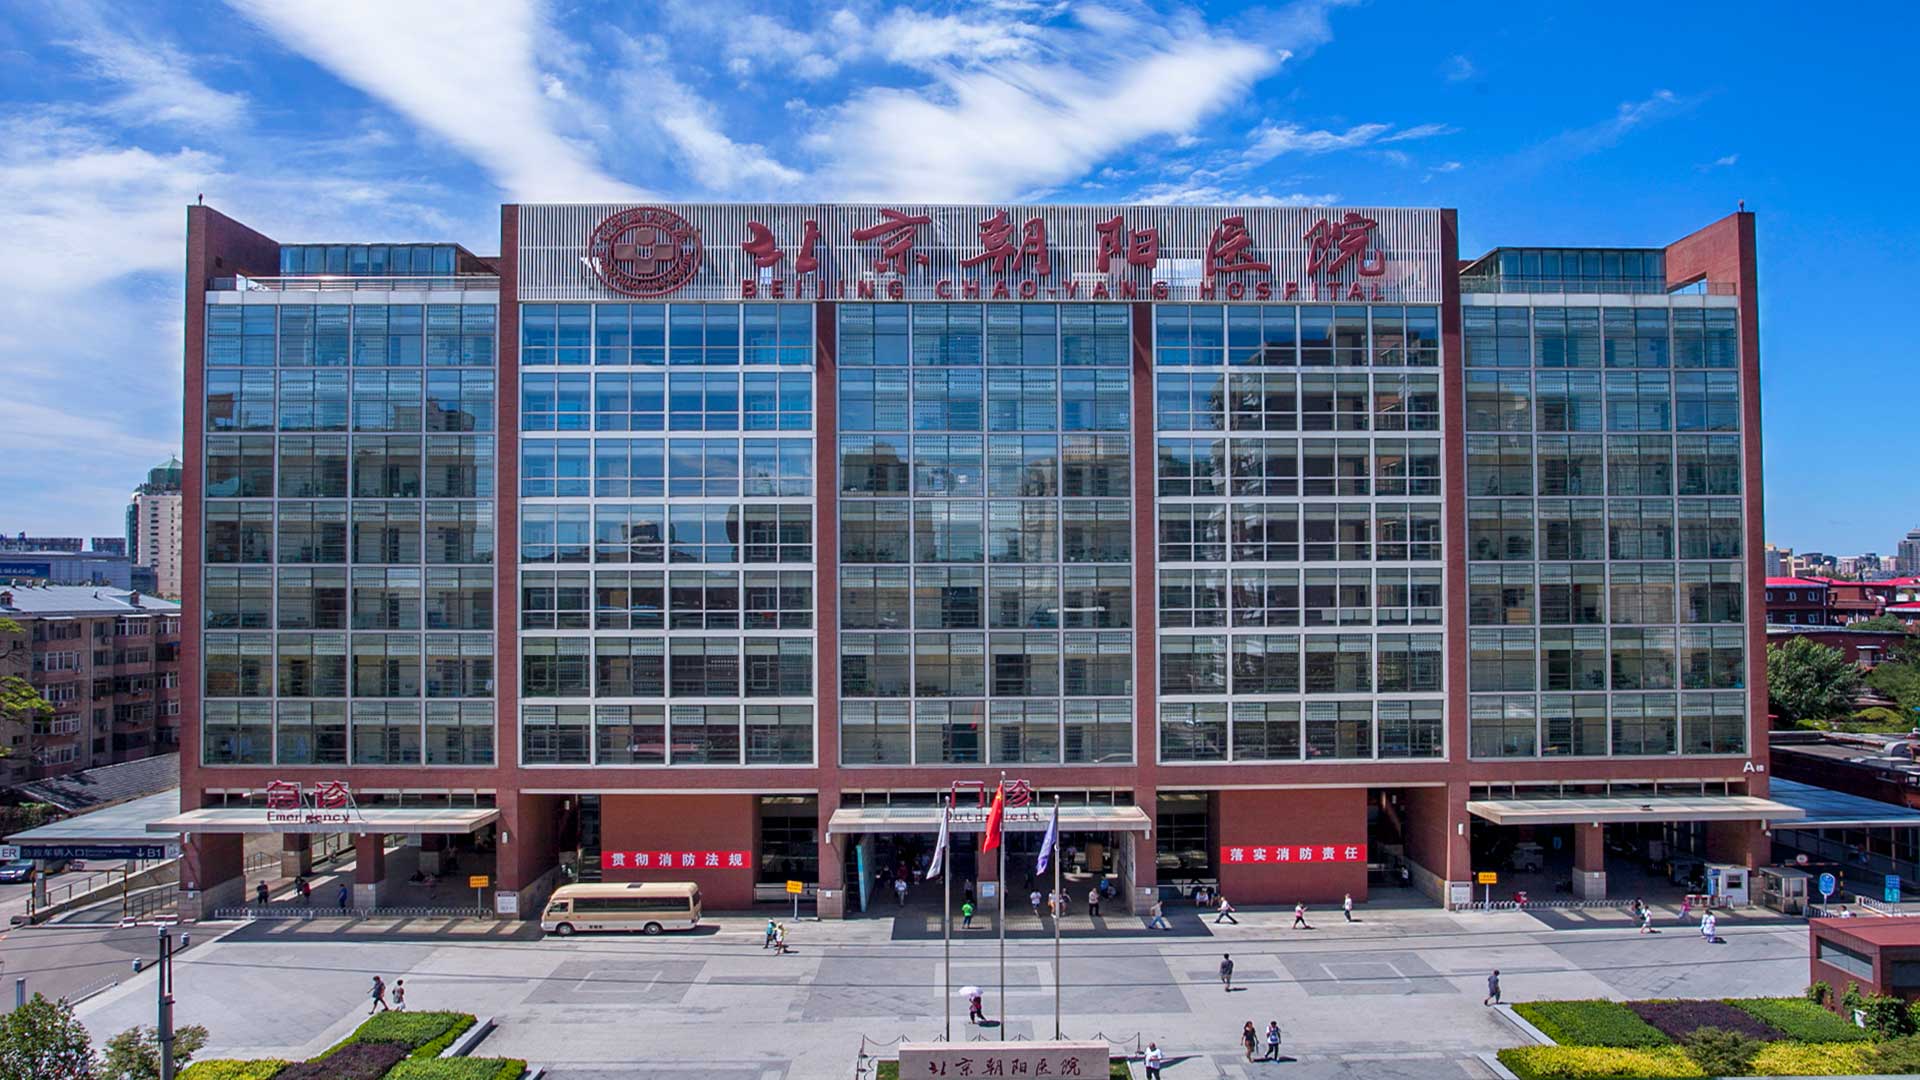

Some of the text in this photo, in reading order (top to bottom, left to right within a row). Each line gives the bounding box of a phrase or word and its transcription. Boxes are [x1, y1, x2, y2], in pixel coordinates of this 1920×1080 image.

[742, 208, 1385, 276] 北京朝阳医院
[742, 279, 1385, 301] BEIJING CHAO-YANG HOSPITAL
[266, 780, 349, 809] 急诊
[267, 812, 350, 824] Emergency
[2, 849, 16, 858] ER
[147, 849, 161, 858] B1
[611, 852, 743, 867] 贯彻消防法规
[1230, 846, 1358, 861] 落实消防责任
[929, 1057, 1081, 1077] 北京朝阳医院
